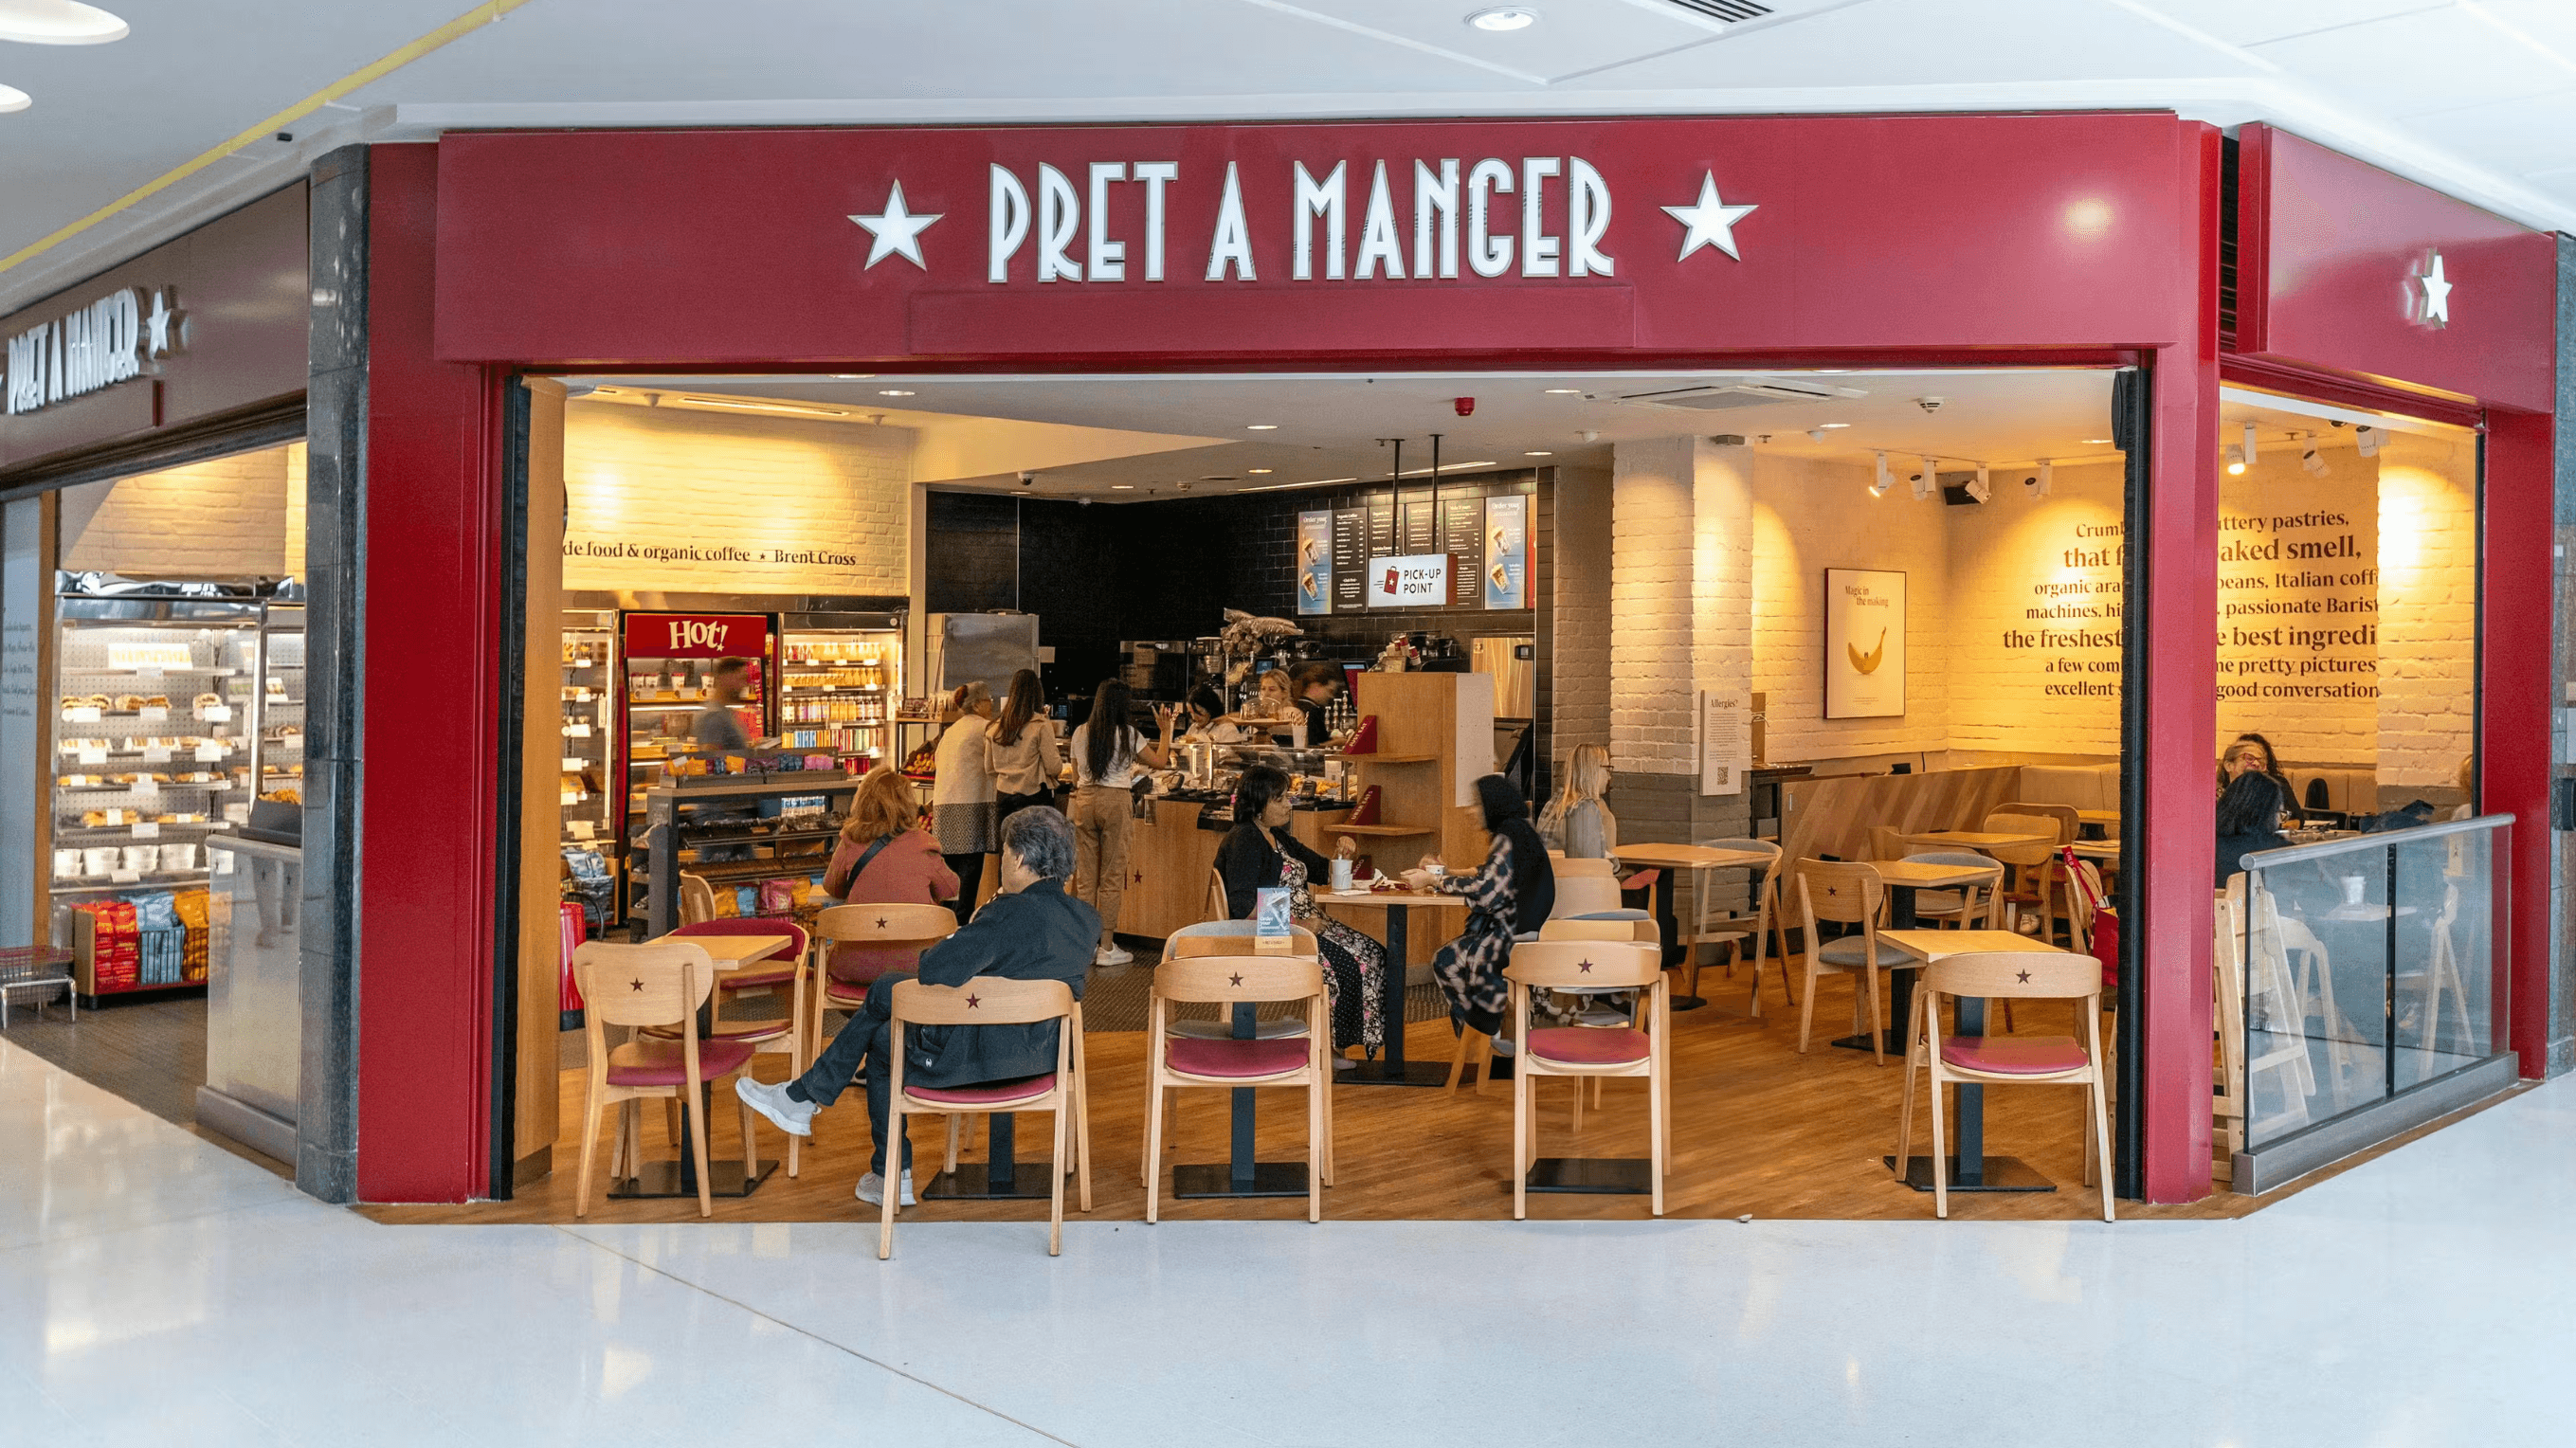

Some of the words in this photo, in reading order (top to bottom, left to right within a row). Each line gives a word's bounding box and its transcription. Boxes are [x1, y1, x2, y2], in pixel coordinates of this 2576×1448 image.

[989, 160, 1179, 282] PRET
[1206, 160, 1257, 281] A
[1292, 155, 1616, 281] MANGER
[2272, 510, 2349, 533] pastries,
[587, 541, 623, 557] food
[627, 544, 639, 557] &
[644, 546, 702, 563] organic
[705, 547, 751, 561] coffee
[775, 550, 815, 564] Brent
[818, 551, 857, 566] Cross
[2063, 547, 2110, 568] that
[2286, 534, 2362, 560] smell,
[1404, 569, 1442, 580] PICK-UP
[2035, 579, 2092, 598] organic
[2276, 571, 2334, 588] Italian
[1404, 583, 1433, 594] POINT
[1845, 586, 1862, 597] Magic
[1862, 586, 1870, 595] in
[1857, 596, 1866, 606] the
[1867, 597, 1889, 608] making
[2225, 599, 2321, 618] passionate
[669, 620, 729, 651] Hot!
[2003, 629, 2035, 649] the
[2040, 628, 2123, 648] freshest
[2233, 626, 2282, 646] best
[2289, 624, 2376, 651] ingredi
[2045, 661, 2054, 673] a
[2058, 658, 2084, 673] few
[2239, 658, 2295, 676] pretty
[2300, 657, 2377, 676] pictures
[2045, 680, 2114, 697] excellent
[2216, 682, 2258, 700] good
[2262, 681, 2379, 697] conversation
[1711, 698, 1738, 710] Allergies?
